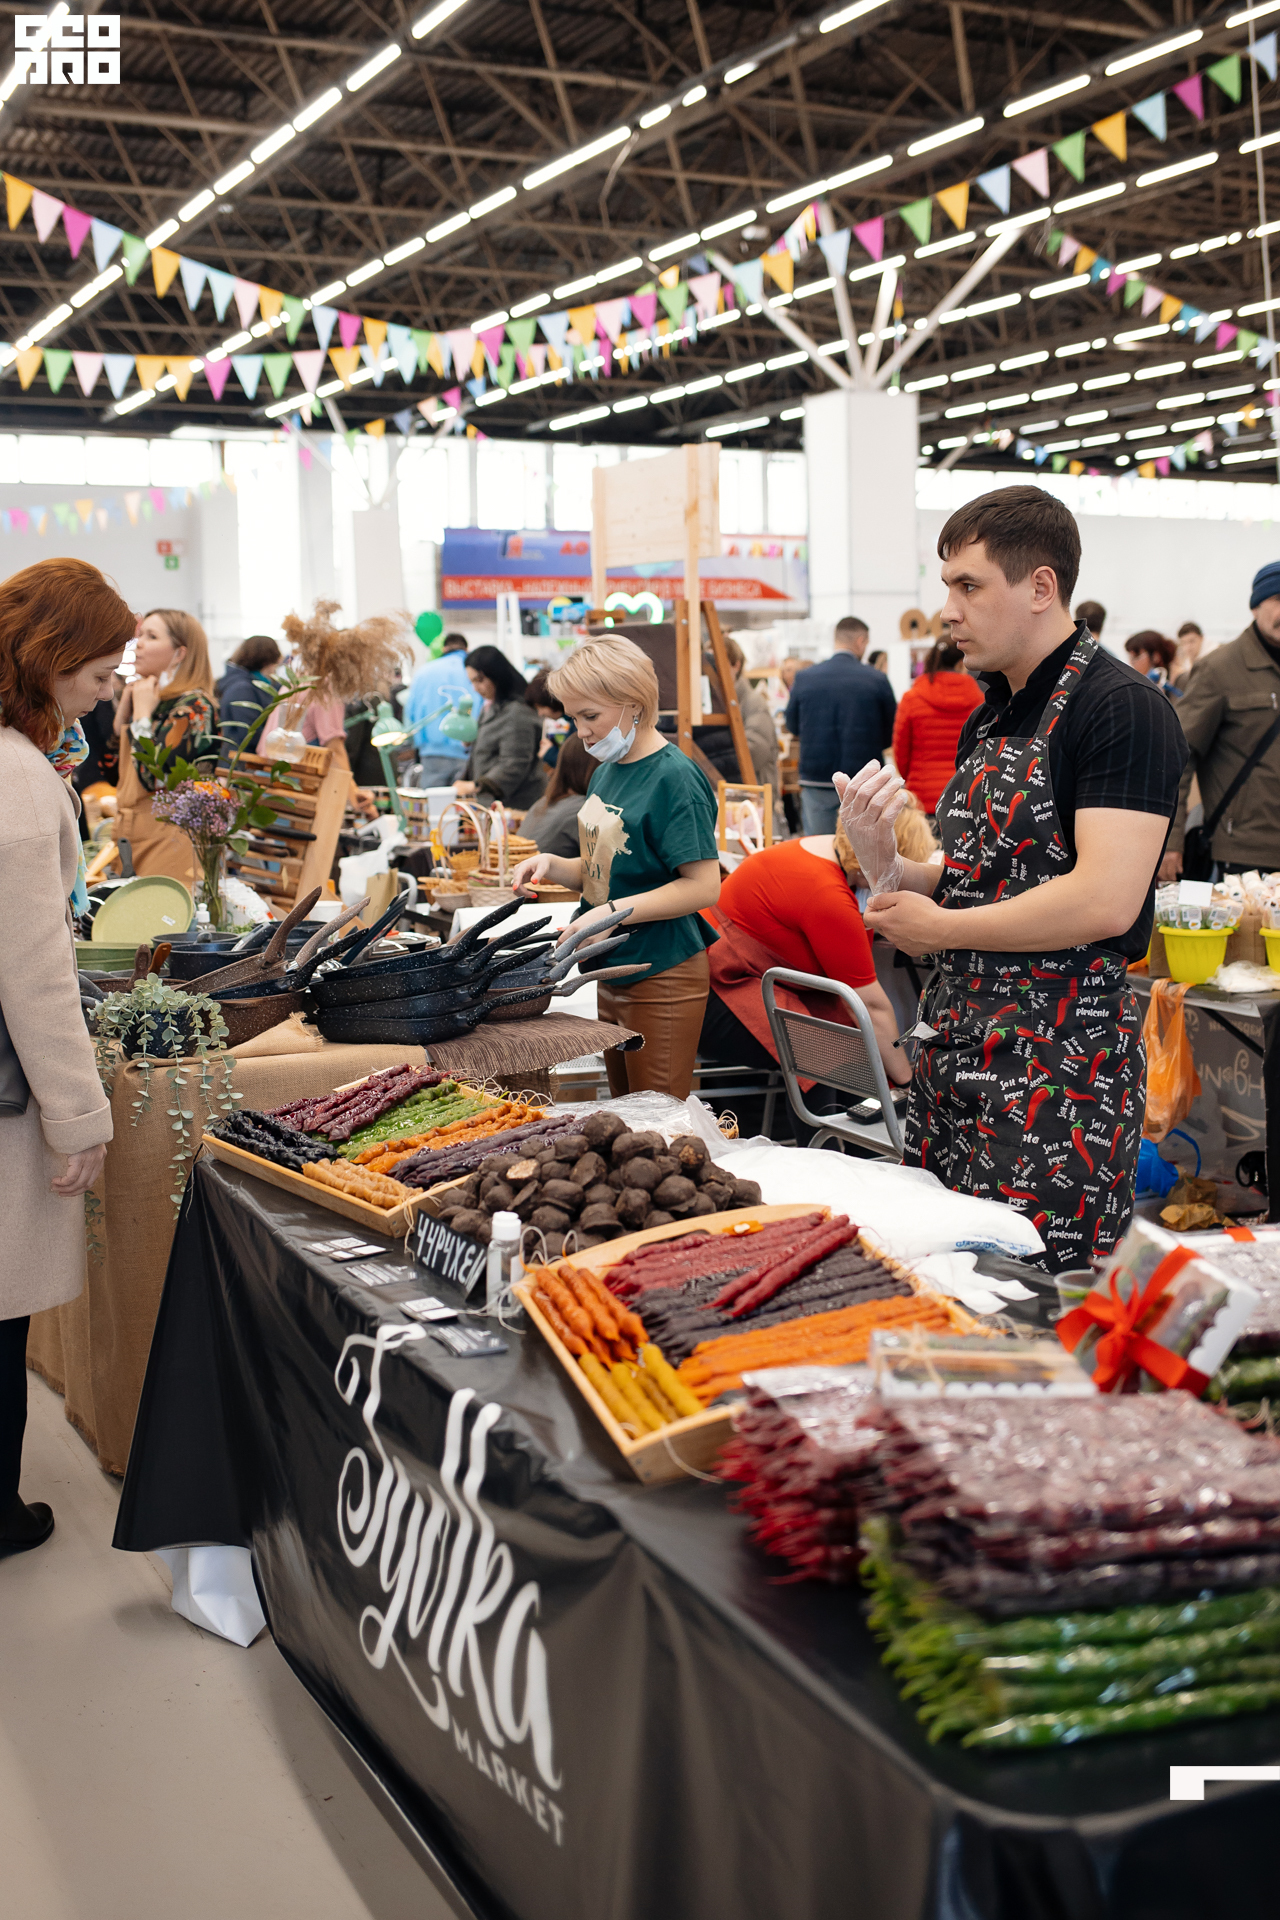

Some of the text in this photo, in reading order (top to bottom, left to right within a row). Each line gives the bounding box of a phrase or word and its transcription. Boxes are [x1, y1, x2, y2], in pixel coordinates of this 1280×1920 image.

[955, 1071, 998, 1082] pimienta
[1019, 1077, 1028, 1085] og
[1043, 1141, 1073, 1154] Salt og
[1047, 1230, 1083, 1240] pimienta
[452, 1714, 564, 1847] MARKET
